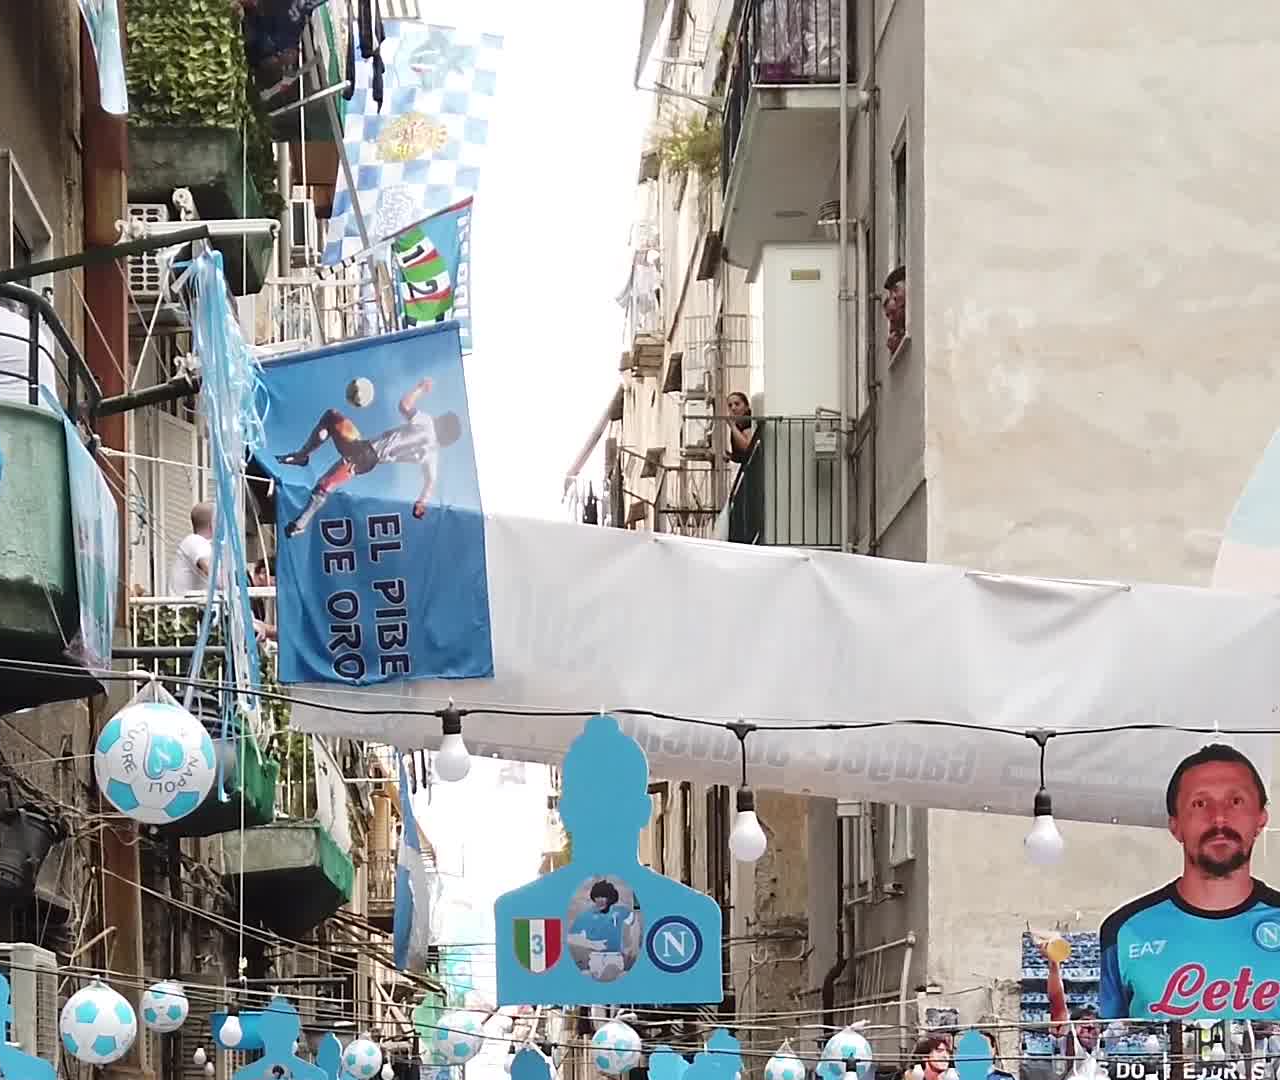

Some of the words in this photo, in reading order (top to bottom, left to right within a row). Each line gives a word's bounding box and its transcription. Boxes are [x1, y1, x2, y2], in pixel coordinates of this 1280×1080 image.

[319, 517, 357, 577] DE
[367, 512, 402, 565] EL
[326, 589, 367, 687] ORO
[372, 577, 411, 677] PIBE
[661, 930, 686, 957] N
[1127, 939, 1168, 960] EA7
